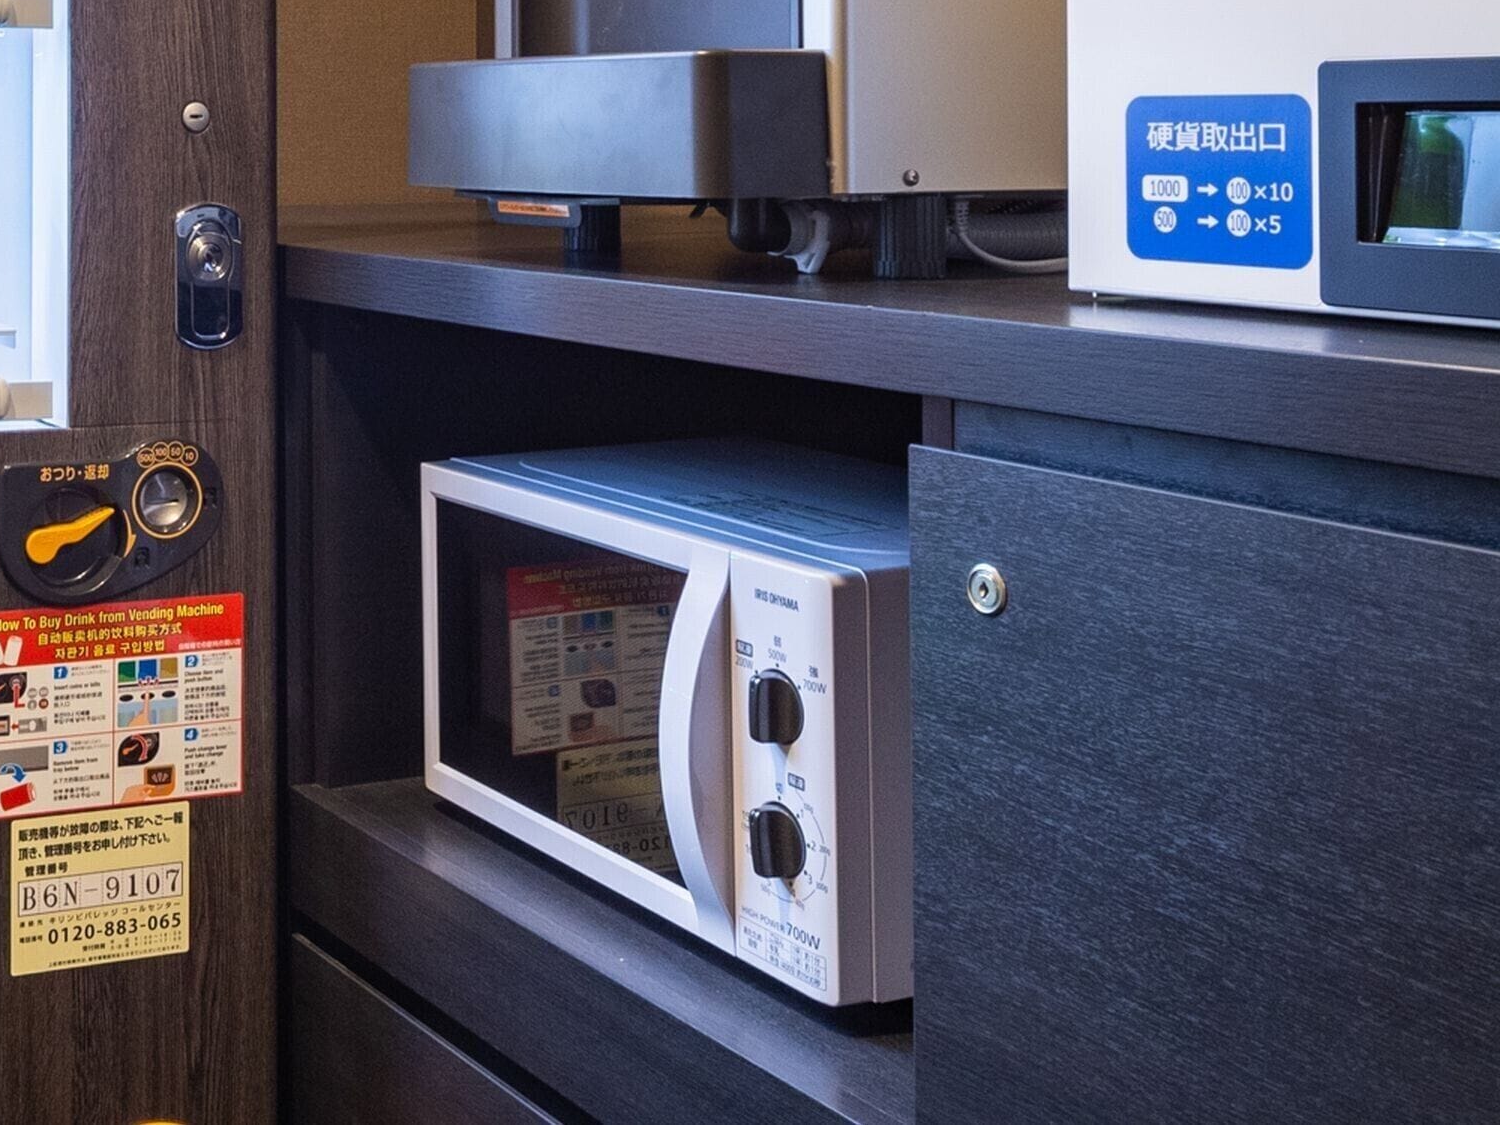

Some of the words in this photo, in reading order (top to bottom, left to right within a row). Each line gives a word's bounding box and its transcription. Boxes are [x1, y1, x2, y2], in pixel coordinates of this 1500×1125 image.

[1146, 122, 1287, 154] 硬貨取出口
[1149, 180, 1181, 198] 1000
[1229, 182, 1248, 200] 100
[1155, 210, 1175, 228] 500
[1229, 214, 1248, 232] 100
[155, 447, 168, 458] 100
[170, 446, 182, 457] 50
[184, 451, 195, 461] 10
[39, 463, 110, 482] おつり・返却
[23, 617, 36, 630] To
[40, 615, 61, 629] Buy
[65, 612, 95, 625] Drink
[99, 610, 125, 623] from
[129, 604, 174, 621] Vending
[177, 602, 224, 617] Machine
[120, 641, 165, 655] 구입방법
[803, 679, 827, 694] 700W
[25, 862, 68, 876] 管理番号
[48, 913, 181, 944] 0120-883-065
[786, 923, 821, 951] 700W
